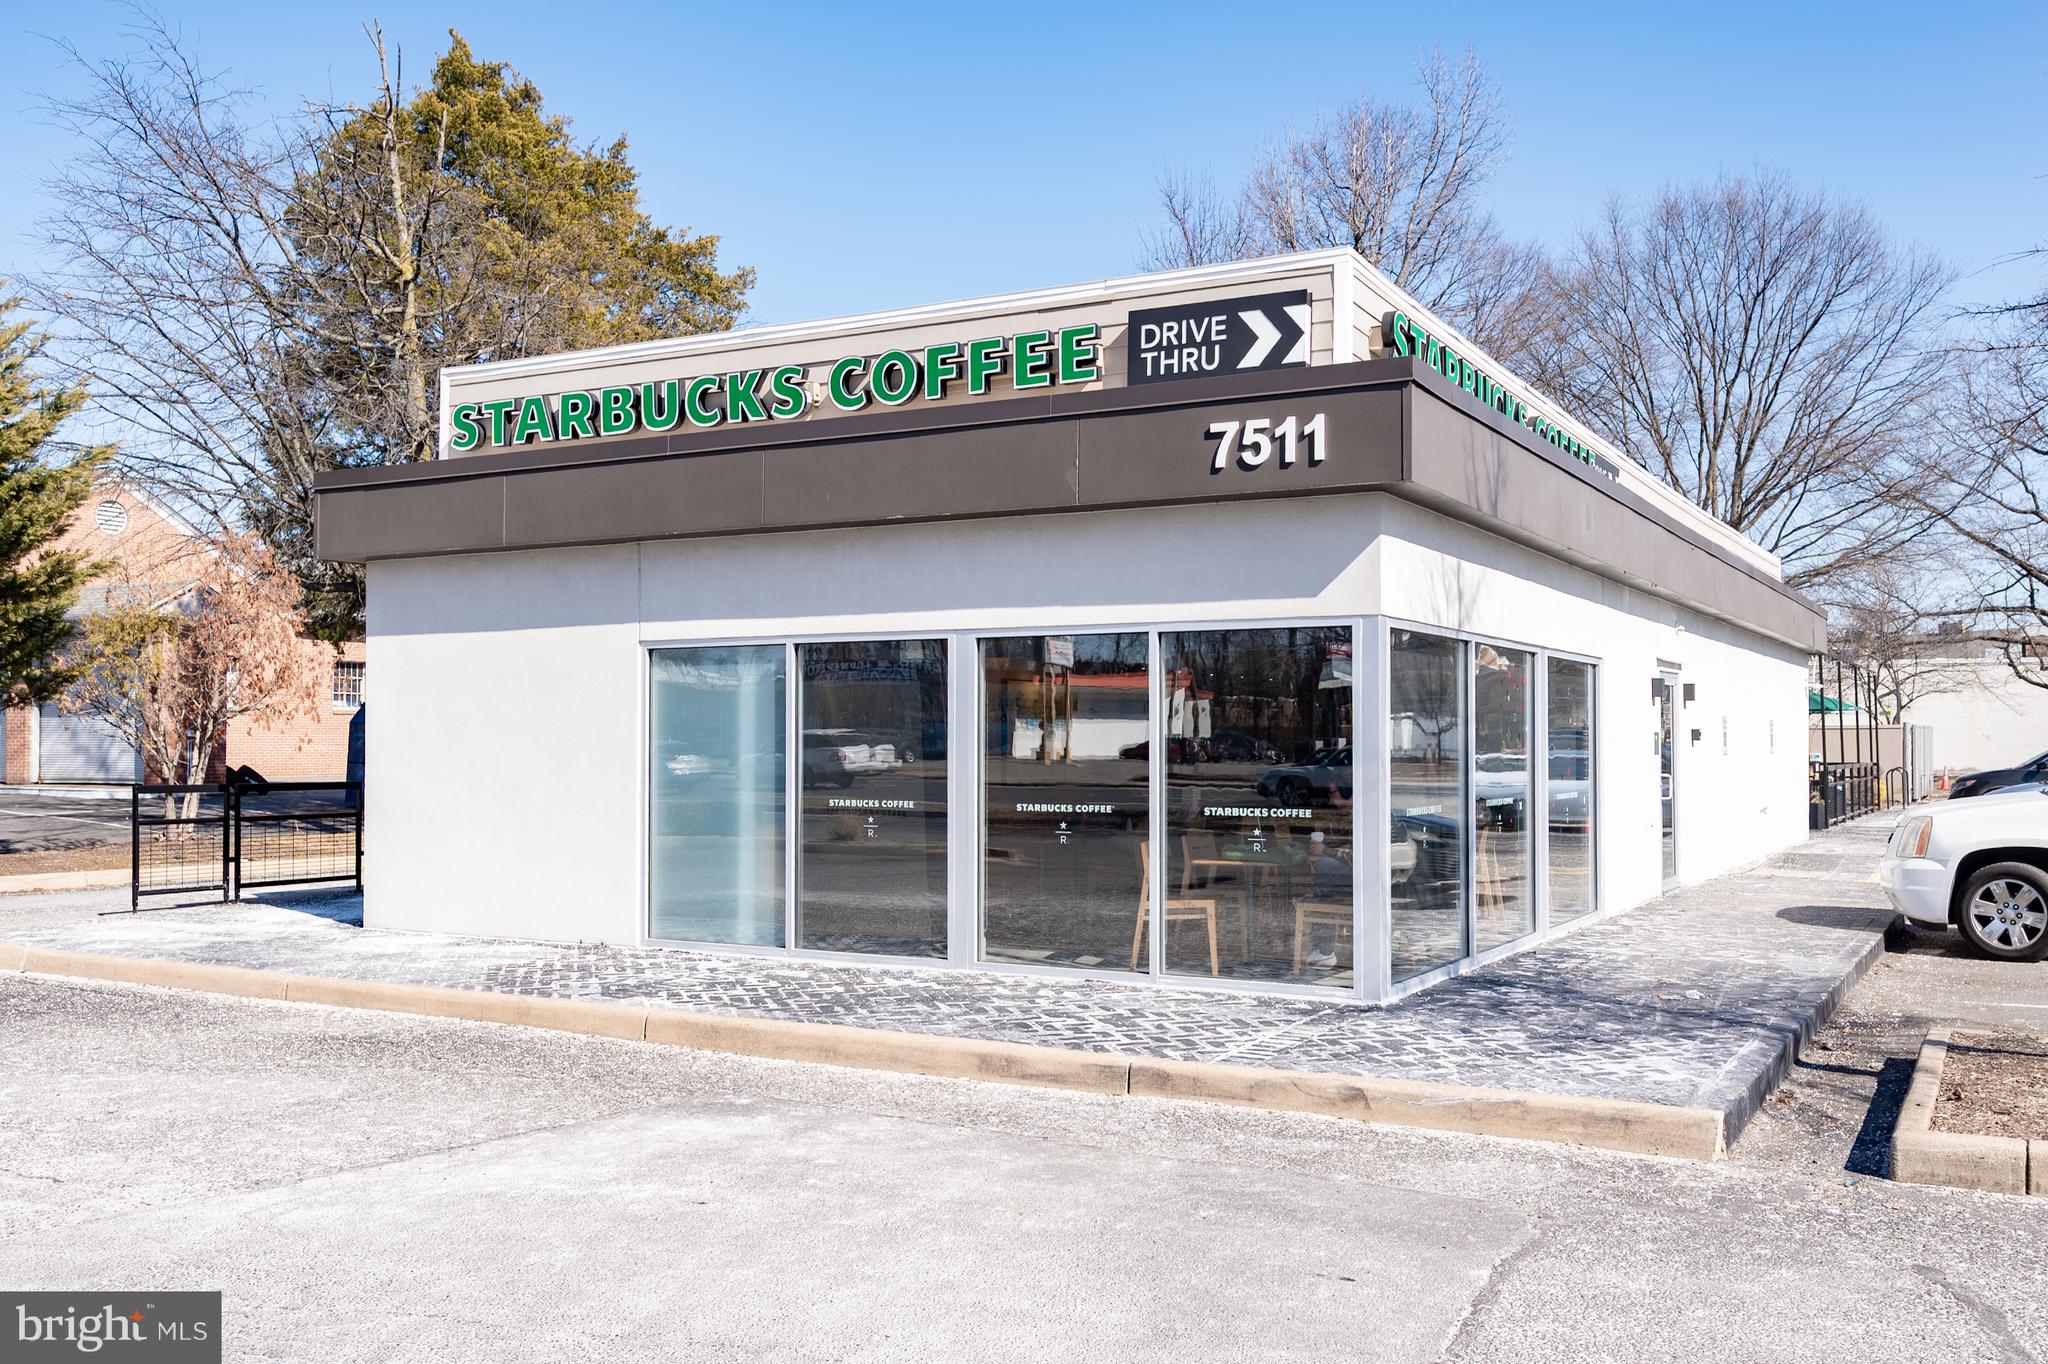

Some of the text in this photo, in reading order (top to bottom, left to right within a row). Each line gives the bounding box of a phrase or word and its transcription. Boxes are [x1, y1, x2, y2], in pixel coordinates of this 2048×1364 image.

[1140, 314, 1228, 350] DRIVE
[1140, 344, 1221, 377] THRU
[450, 322, 1100, 452] STARBUCKS COFFEE
[1208, 412, 1326, 469] 7511
[828, 799, 915, 809] STARBUCKS COFFEE
[1016, 803, 1113, 814] STARBUCKS COFFEE
[1203, 807, 1313, 818] STARBUCKS COFFEE
